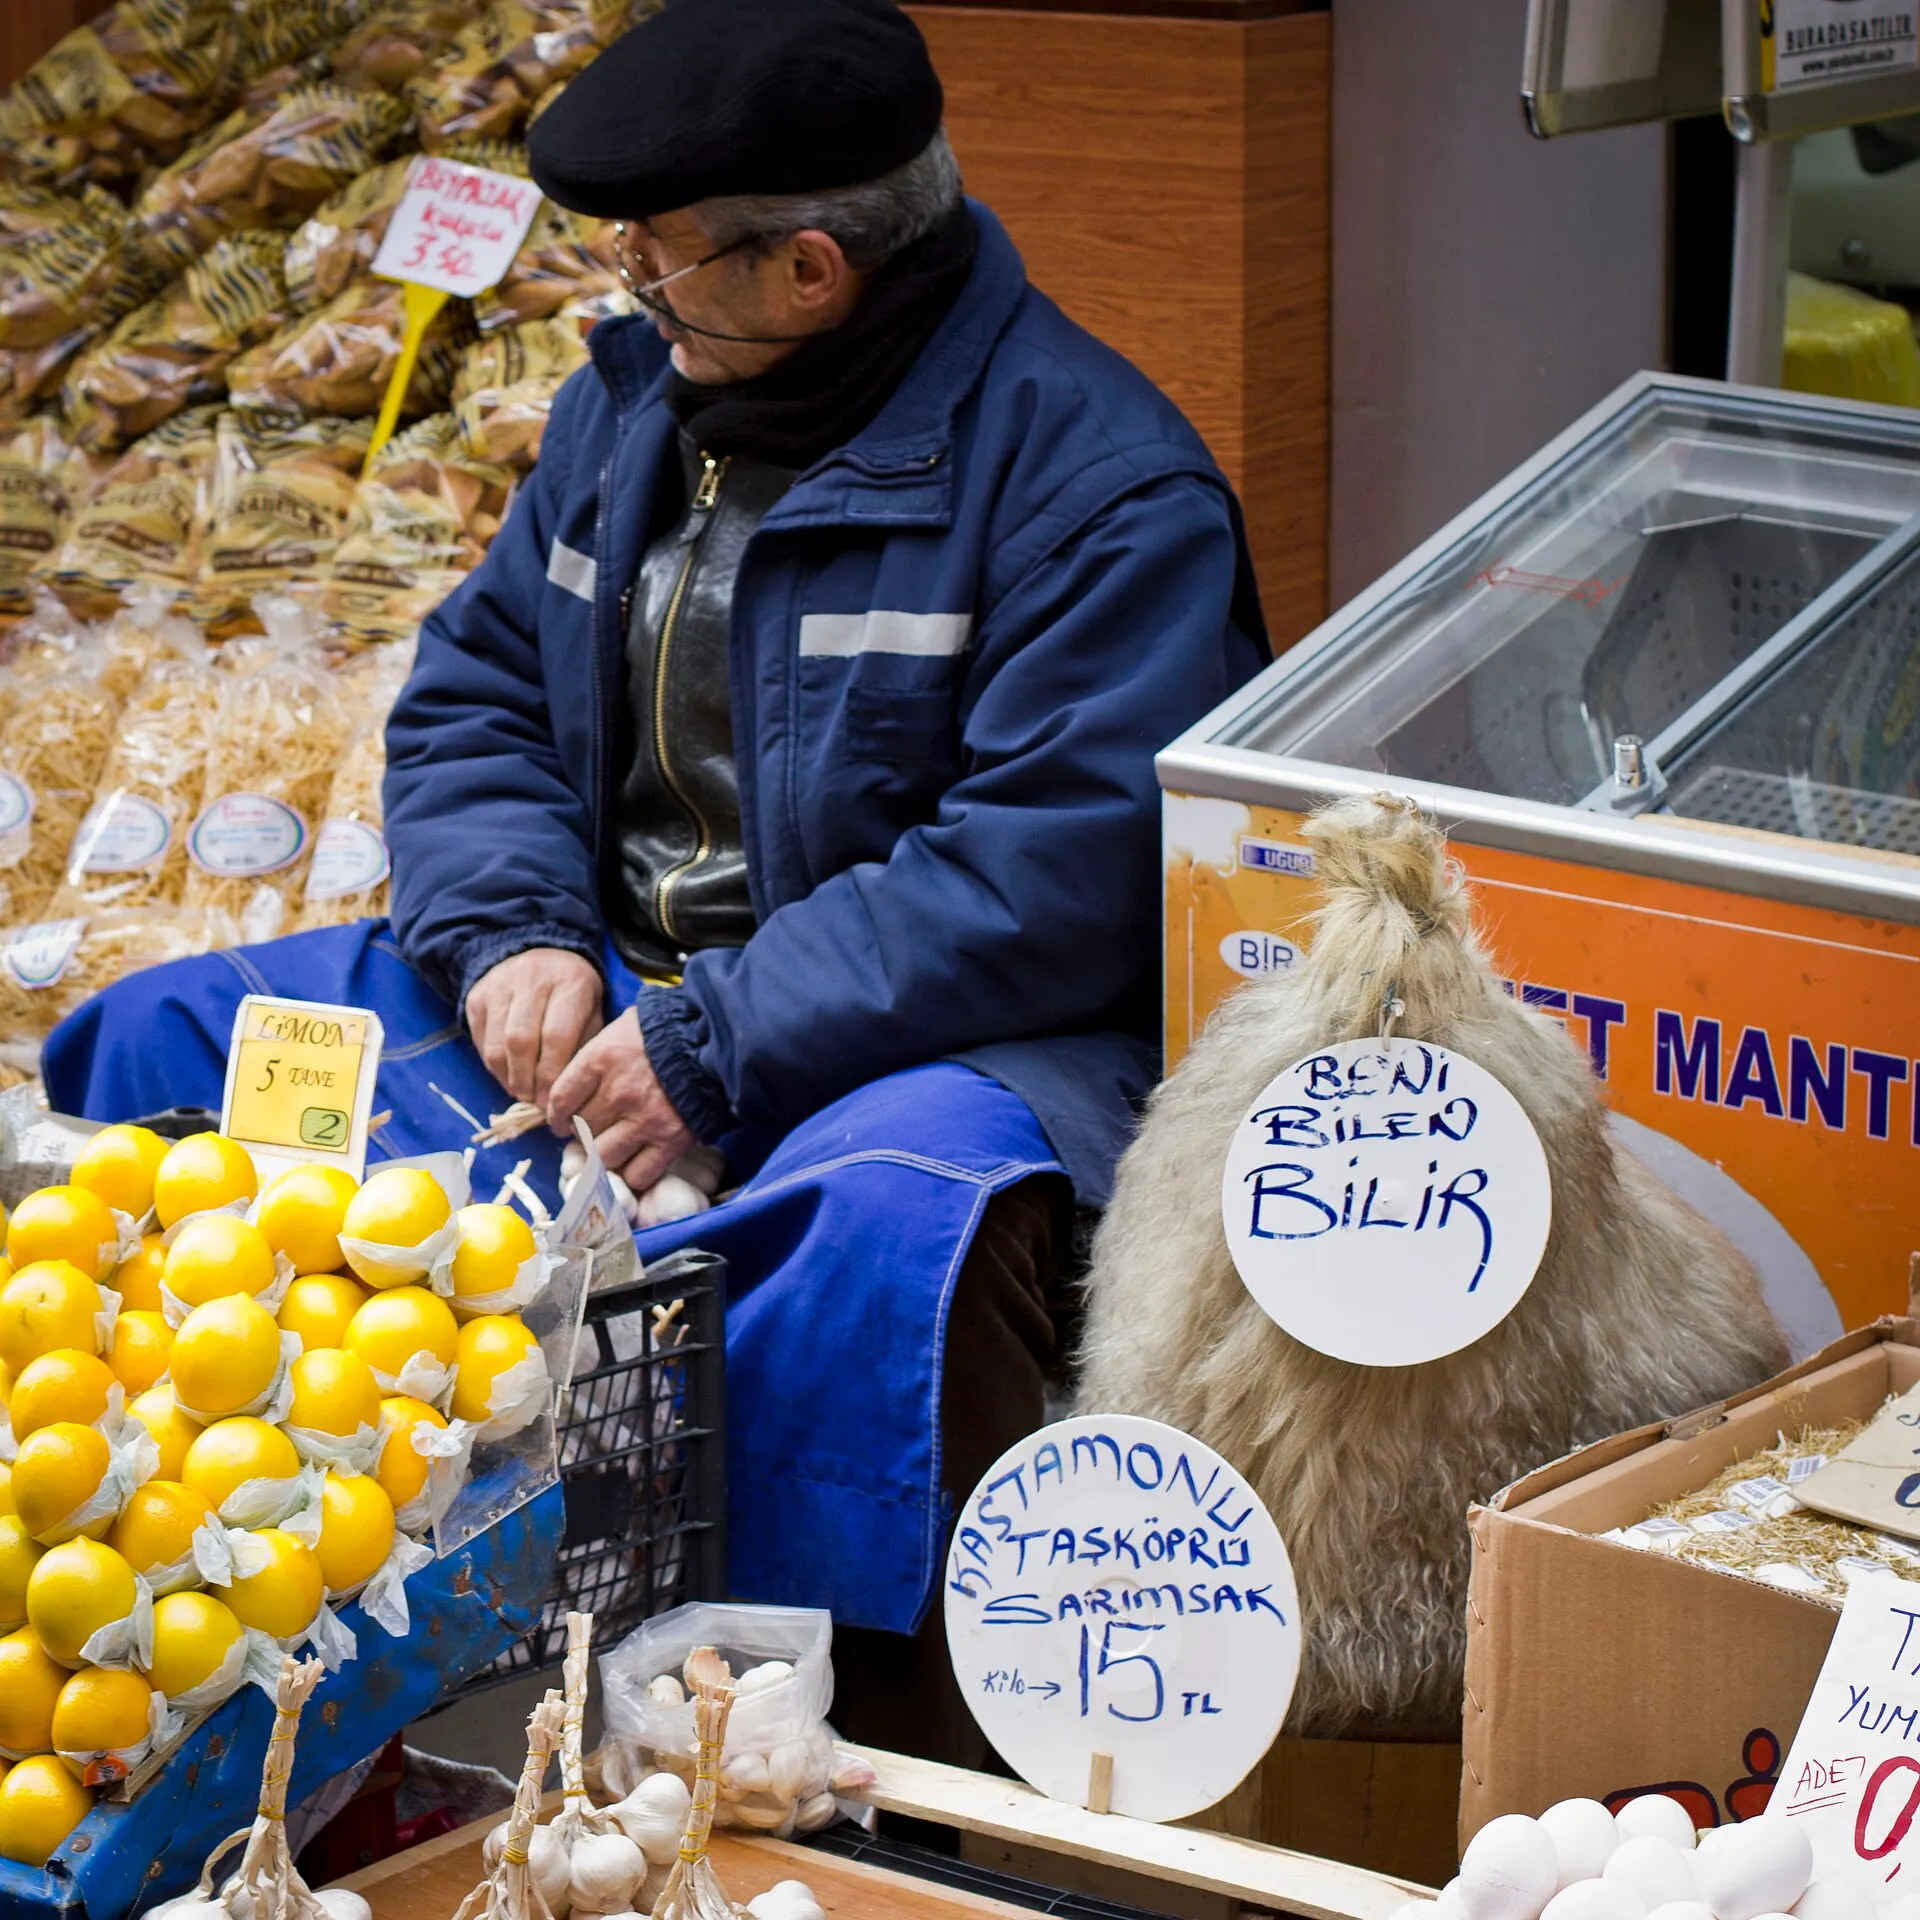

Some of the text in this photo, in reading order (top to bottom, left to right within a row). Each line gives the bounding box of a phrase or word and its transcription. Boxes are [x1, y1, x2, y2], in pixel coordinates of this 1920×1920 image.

[255, 1058, 336, 1092] 5 TANE
[312, 1113, 341, 1141] 2
[949, 1433, 1254, 1600] KASTAMONU
[1078, 1620, 1167, 1723] 15
[1181, 1692, 1223, 1717] TL
[1838, 1685, 1920, 1743] YUM
